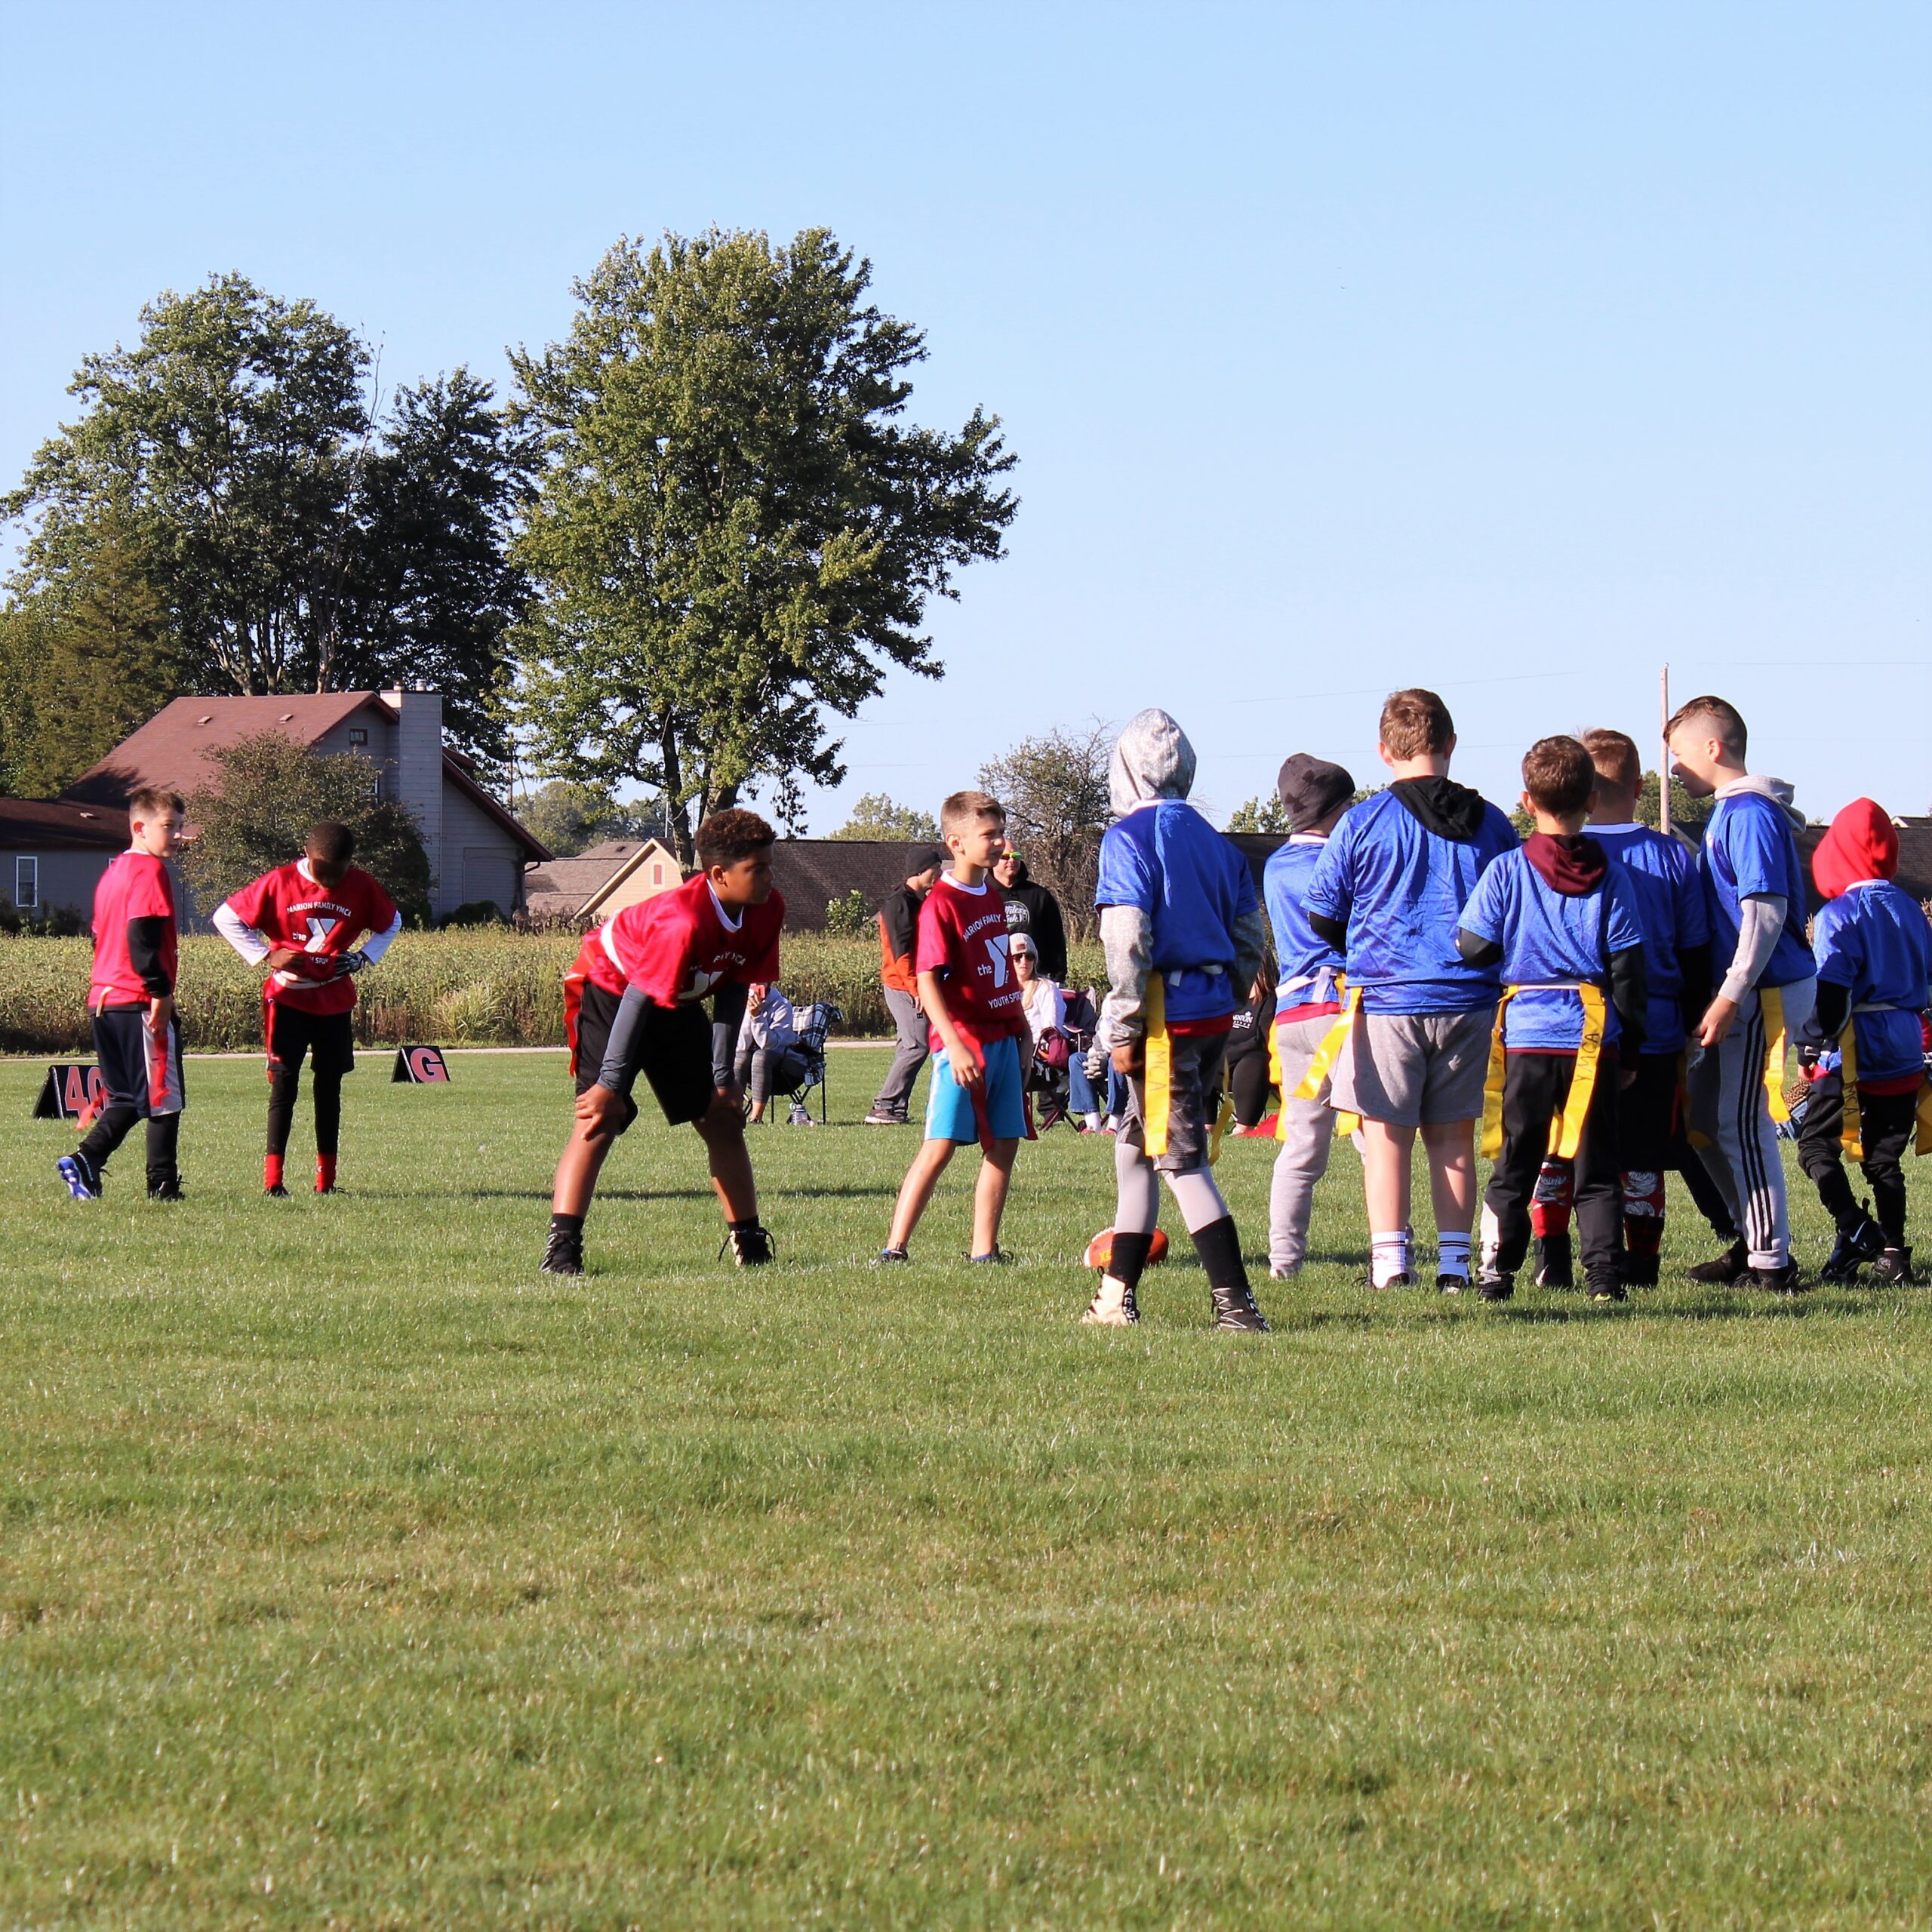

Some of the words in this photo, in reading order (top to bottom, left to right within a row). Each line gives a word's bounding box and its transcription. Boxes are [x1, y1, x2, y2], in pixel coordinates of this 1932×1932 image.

[314, 901, 336, 910] FAMILY
[336, 905, 352, 918] YMCA
[292, 931, 306, 941] the
[963, 918, 983, 943] MARION
[982, 914, 1001, 925] FAMILY
[977, 964, 992, 976] the
[988, 995, 1010, 1009] YOUTH
[410, 1048, 448, 1083] G
[1146, 1038, 1169, 1092] YMCA
[1574, 1033, 1599, 1082] YMCA
[64, 1066, 109, 1120] 40
